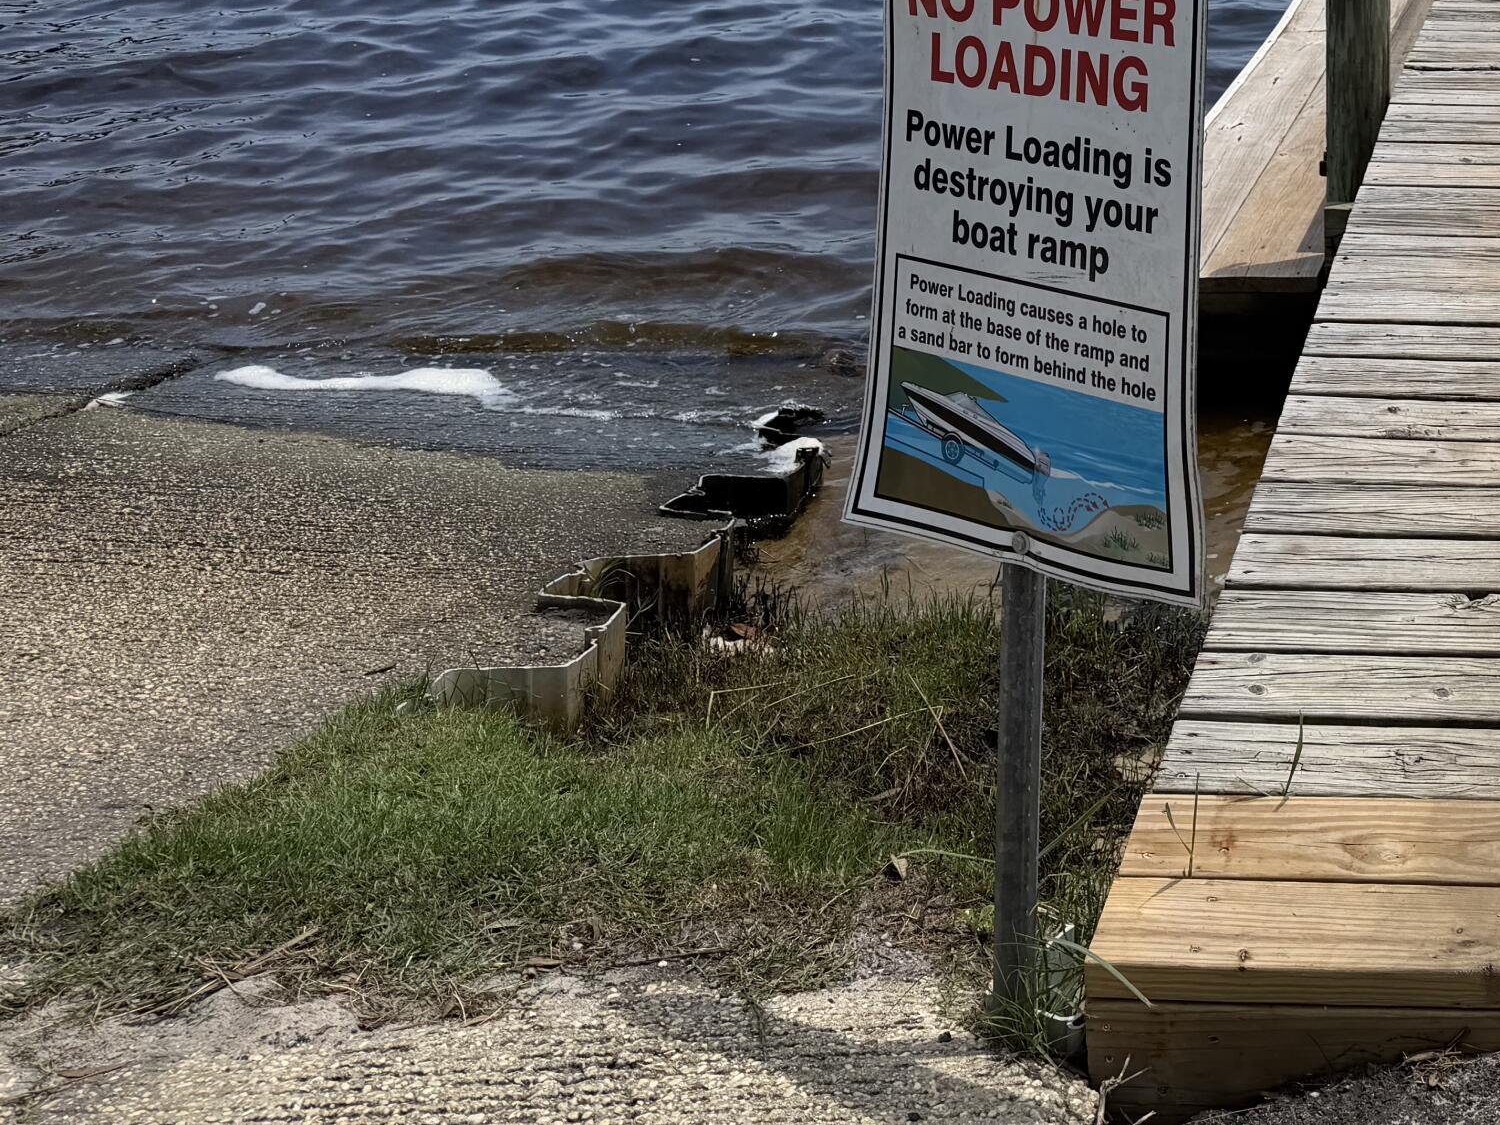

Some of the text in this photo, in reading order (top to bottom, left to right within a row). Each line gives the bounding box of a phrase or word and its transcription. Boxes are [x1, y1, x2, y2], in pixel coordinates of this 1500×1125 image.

[931, 32, 1148, 112] LOADING
[906, 109, 1171, 189] Power Loading is
[914, 158, 1158, 234] destroying your
[952, 210, 1109, 281] boat ramp
[906, 299, 1150, 372] form at the base of the ramp and
[910, 274, 1147, 343] Power Loading causes a hole to
[898, 325, 1156, 401] a sand bar to form behind the hole
